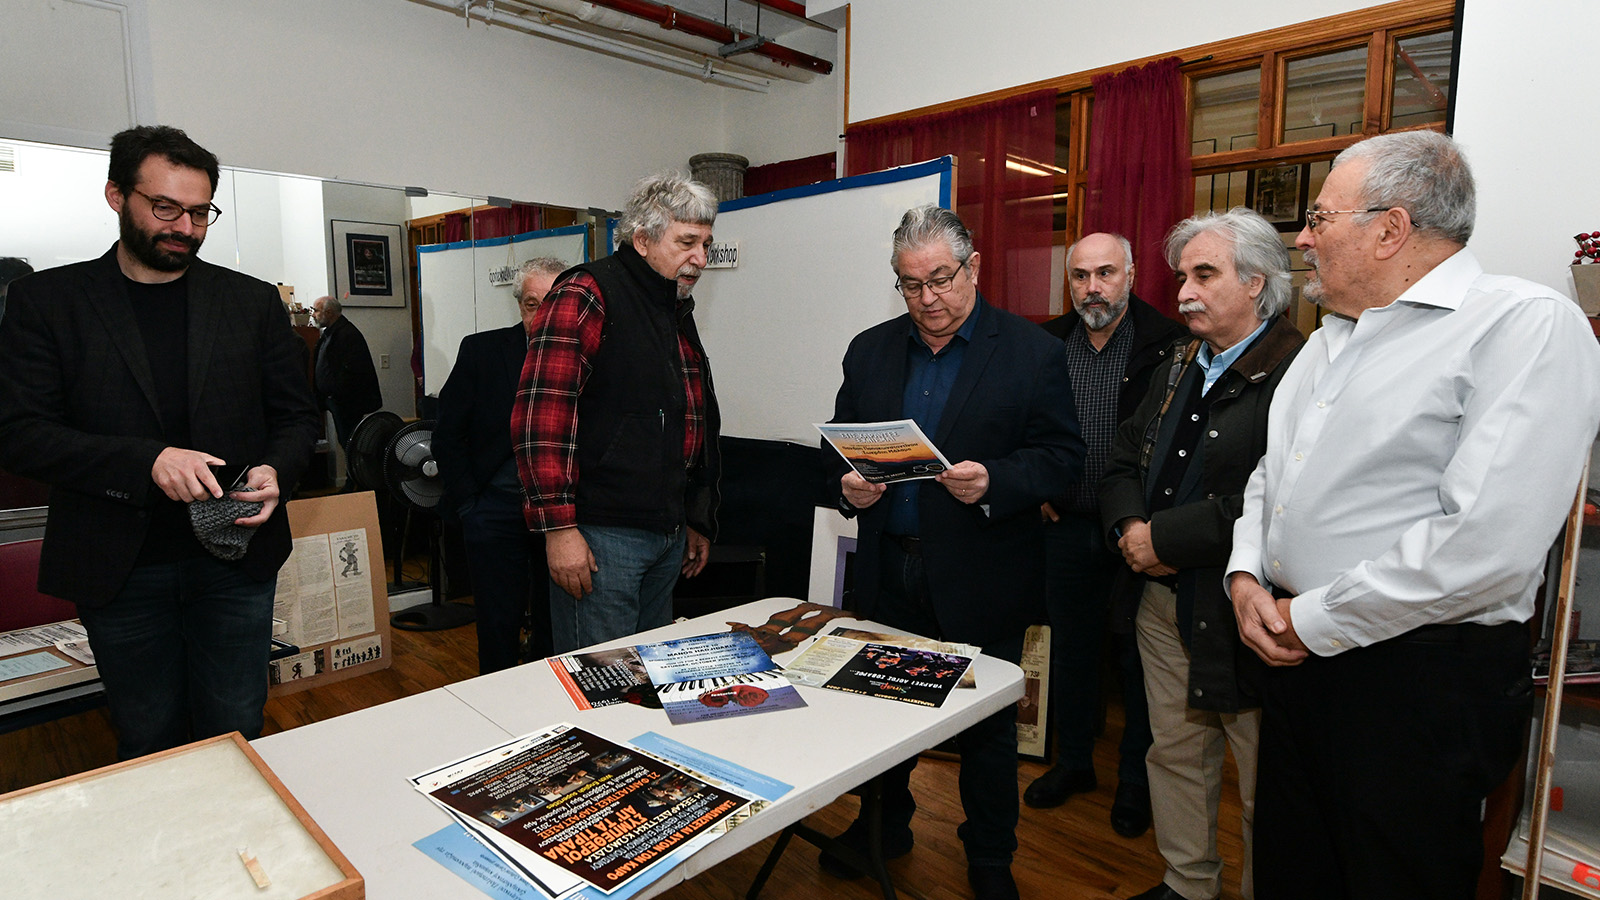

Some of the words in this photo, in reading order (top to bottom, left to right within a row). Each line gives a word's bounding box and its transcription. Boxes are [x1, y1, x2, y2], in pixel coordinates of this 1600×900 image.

[610, 764, 645, 782] Παρασκευή
[645, 771, 661, 779] 21
[574, 780, 601, 793] English
[579, 783, 610, 799] Σάββατο
[588, 786, 618, 802] Κυριακή
[592, 776, 652, 808] ΦΑΝΤΑΣΤΙΚΕΣ
[534, 805, 568, 823] Κυριακές
[555, 799, 594, 820] Δεκεμβρίου
[679, 799, 737, 835] ΞΑΝΑΠΑΙΖΕΤΑΙ
[530, 821, 552, 833] 2012
[535, 805, 599, 839] ΠΑΡΑΣΤΑΣΕΙΣ
[592, 817, 618, 831] ΤΑ
[541, 828, 599, 860] ΤΙΡΑΝΑ
[559, 812, 649, 864] ΣΥΜΠΕΘΕΡΟΙ
[583, 832, 636, 863] ΚΩΜΩΔΙΑ
[651, 831, 685, 852] ΑΥΤΟΝ
[632, 848, 658, 863] ΤΟΝ
[604, 859, 639, 880] ΚΑΙΡΟ
